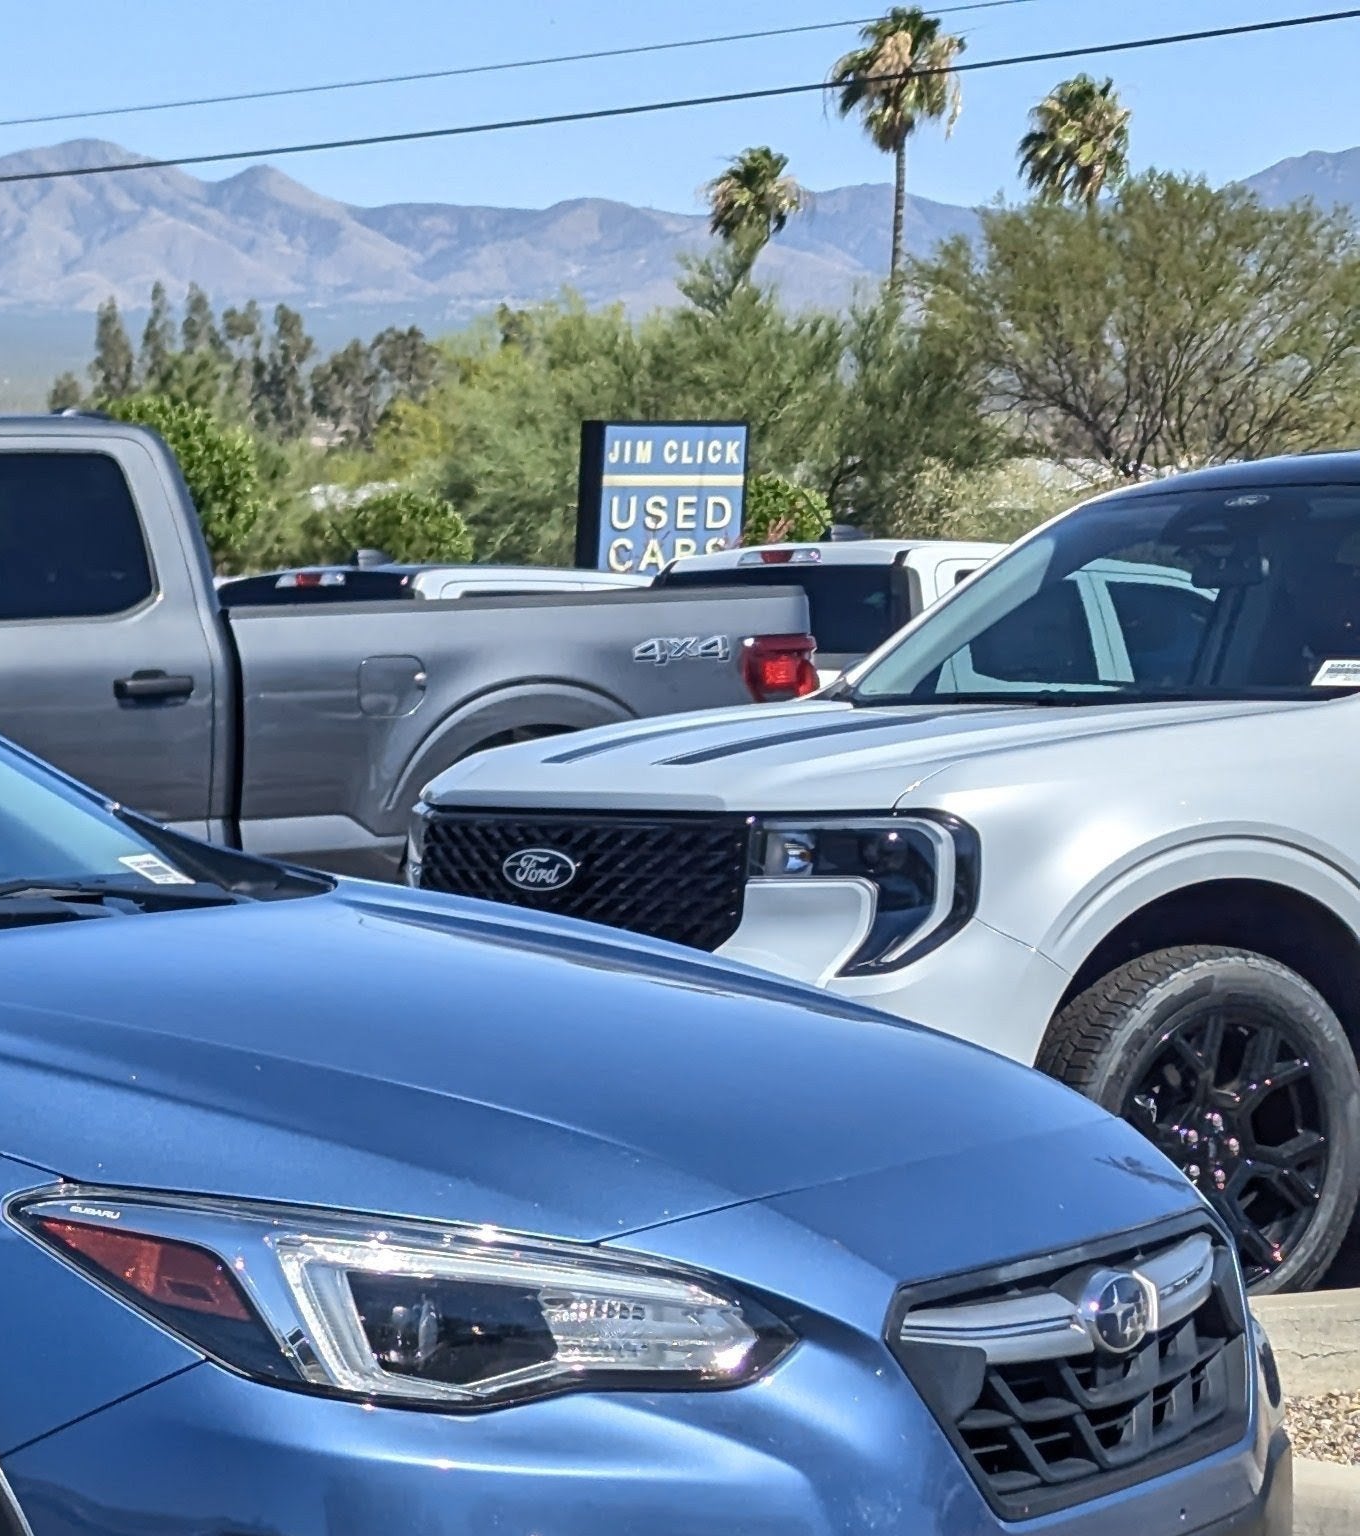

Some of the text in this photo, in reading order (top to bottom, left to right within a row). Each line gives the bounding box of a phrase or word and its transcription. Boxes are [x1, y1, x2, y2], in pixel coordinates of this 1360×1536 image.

[608, 440, 740, 464] JIM CLICK
[611, 495, 732, 530] USED
[515, 854, 562, 884] Ford
[69, 1205, 121, 1219] SUBARU
